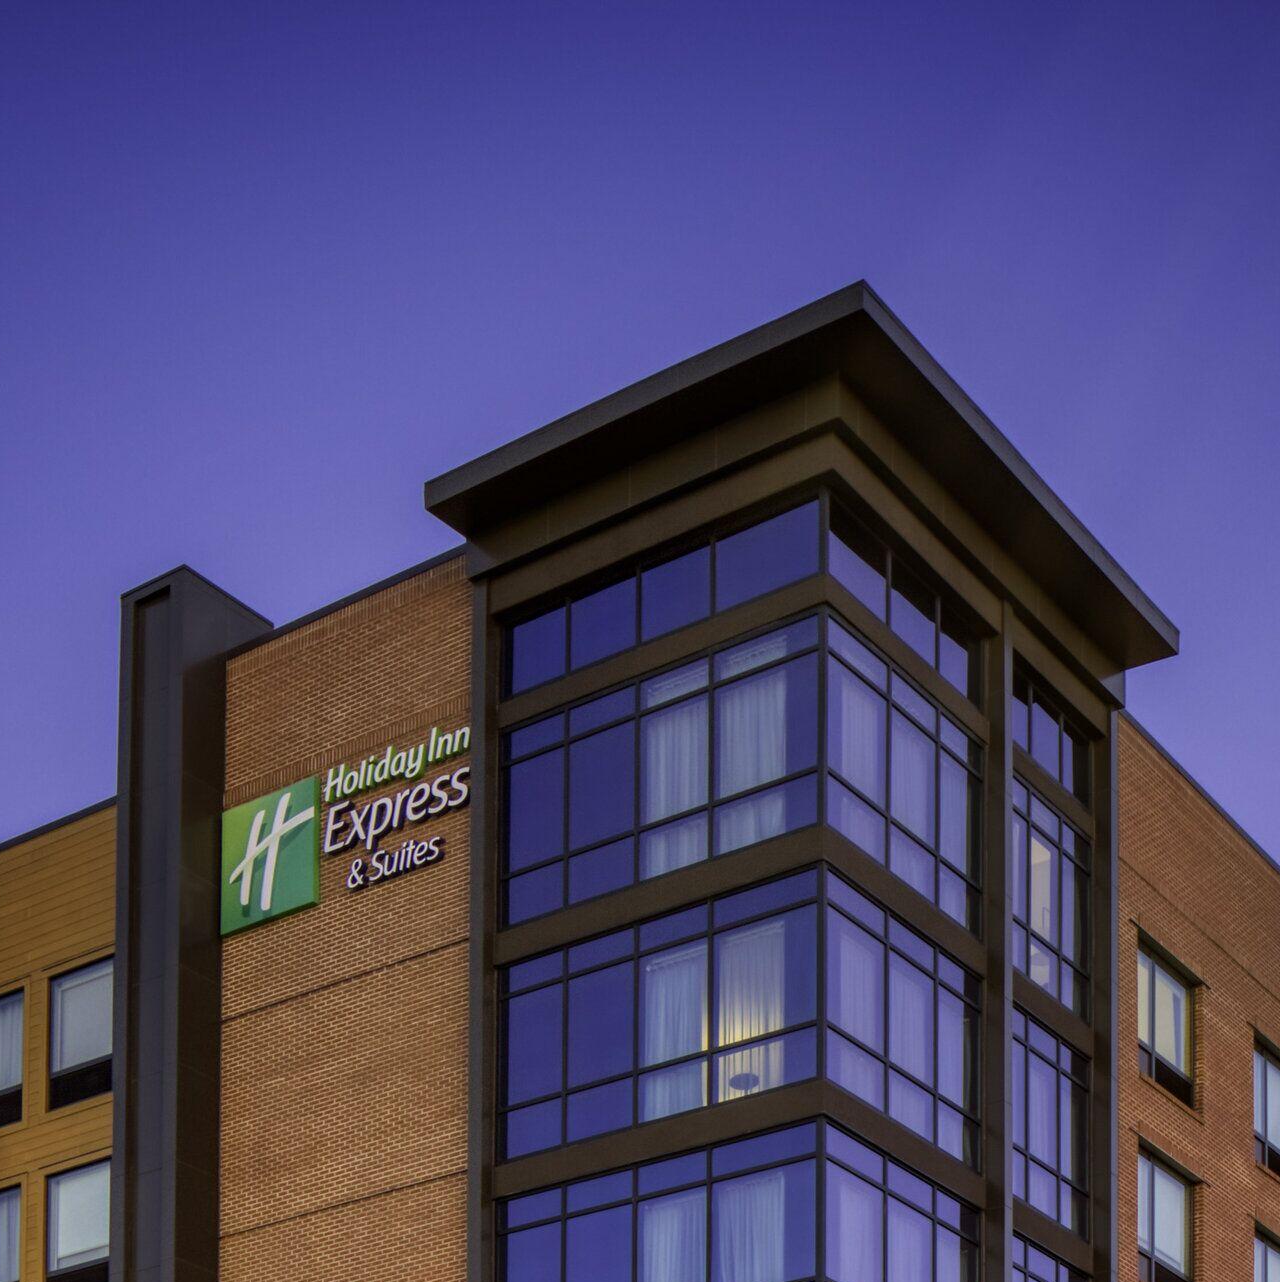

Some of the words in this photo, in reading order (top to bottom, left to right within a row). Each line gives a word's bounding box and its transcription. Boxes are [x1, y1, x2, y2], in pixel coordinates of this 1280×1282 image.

[323, 743, 425, 802] Holiday
[428, 726, 470, 762] Inn
[323, 766, 470, 853] Express
[347, 858, 364, 889] &
[369, 836, 441, 881] Suites
